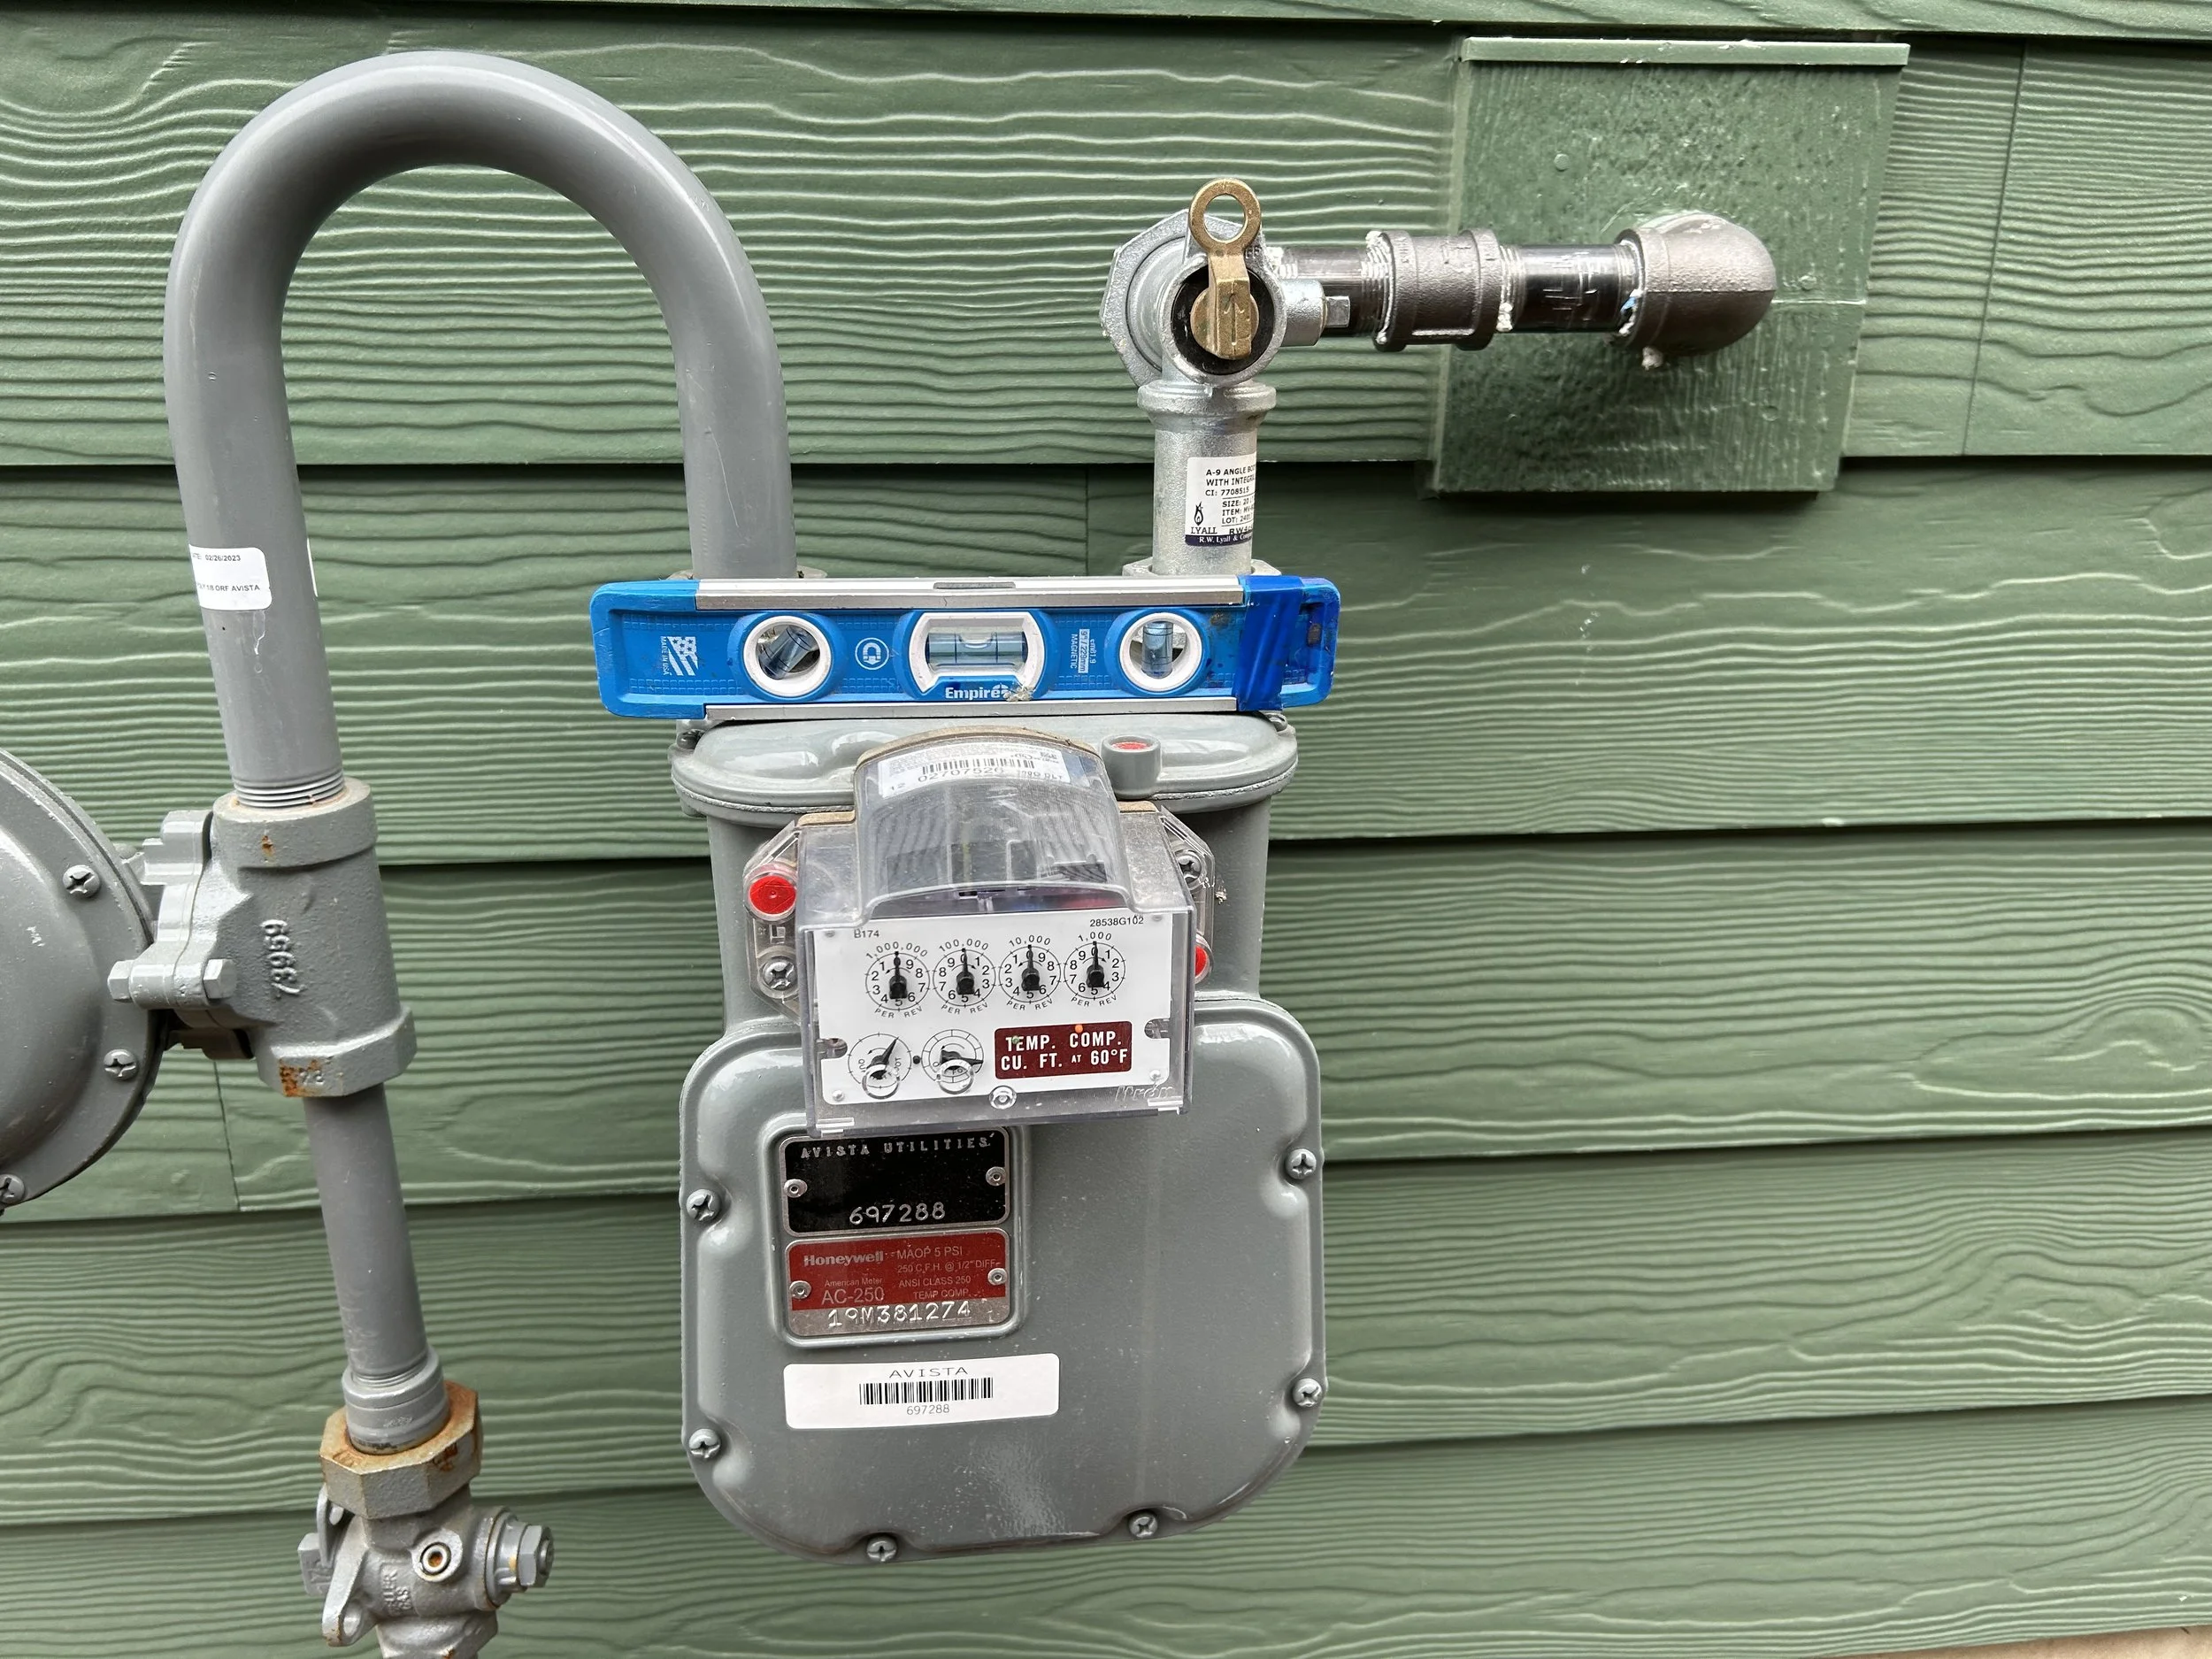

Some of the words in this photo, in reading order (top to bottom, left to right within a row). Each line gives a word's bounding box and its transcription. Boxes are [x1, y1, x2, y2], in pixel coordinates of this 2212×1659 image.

[1223, 466, 1246, 475] ANGLE
[1221, 486, 1249, 495] 7708515
[1216, 535, 1231, 544] Lyall
[1070, 634, 1079, 669] MAGNETIC
[945, 687, 1001, 700] Empire
[1089, 916, 1144, 927] 28538G102
[854, 929, 879, 939] B174
[1078, 931, 1112, 942] 1,000
[939, 938, 989, 952] 100,000
[1009, 934, 1051, 947] 10,000
[865, 941, 928, 959] 1,000,000
[1079, 950, 1087, 960] 9
[1105, 949, 1110, 959] 1
[947, 957, 956, 967] 9
[975, 956, 980, 966] 1
[1012, 954, 1018, 964] 1
[1038, 952, 1046, 962] 9
[879, 961, 886, 971] 1
[905, 959, 914, 970] 9
[1048, 961, 1055, 971] 8
[1070, 960, 1078, 970] 8
[1111, 958, 1119, 968] 2
[915, 968, 924, 978] 8
[939, 967, 947, 977] 8
[981, 964, 990, 975] 2
[1004, 964, 1012, 973] 2
[871, 971, 879, 981] 2
[1049, 976, 1057, 986] 7
[1070, 974, 1078, 984] 7
[1111, 972, 1119, 981] 3
[918, 982, 926, 992] 7
[939, 981, 946, 991] 7
[982, 979, 990, 988] 3
[1005, 977, 1013, 987] 3
[1079, 982, 1086, 992] 6
[1102, 981, 1110, 991] 4
[872, 985, 880, 995] 3
[948, 989, 956, 1000] 6
[973, 988, 981, 998] 4
[1012, 986, 1020, 996] 4
[1026, 990, 1034, 999] 5
[1039, 985, 1047, 995] 6
[1091, 987, 1098, 995] 5
[880, 994, 889, 1003] 4
[907, 991, 916, 1002] 6
[961, 994, 969, 1003] 5
[1071, 996, 1090, 1007] PER
[1099, 995, 1118, 1006] REV
[941, 1003, 961, 1015] PER
[969, 1002, 988, 1014] REV
[1006, 999, 1025, 1010] PER
[1034, 998, 1053, 1010] REV
[874, 1008, 895, 1018] PER
[903, 1006, 923, 1018] REV
[1005, 1034, 1056, 1052] TEMP.
[1069, 1031, 1122, 1048] COMP.
[1001, 1055, 1027, 1071] CU.
[1039, 1052, 1063, 1068] FT.
[1071, 1054, 1081, 1064] AT
[1090, 1048, 1128, 1065] 60°F
[801, 1144, 870, 1159] AVISTA
[884, 1137, 990, 1154] UTILITIES
[849, 1201, 946, 1225] 697288
[803, 1250, 884, 1266] Honeywell
[896, 1248, 931, 1260] MAOP
[934, 1247, 941, 1257] 5
[944, 1246, 963, 1256] PSI
[897, 1263, 913, 1273] 250
[945, 1262, 955, 1271] @
[898, 1279, 920, 1287] ANSI
[923, 1277, 953, 1286] CLASS
[956, 1275, 972, 1284] 250
[821, 1286, 885, 1305] AC-250
[827, 1301, 972, 1327] 19M381274
[888, 1366, 969, 1379] AVISTA
[906, 1403, 950, 1416] 697288
